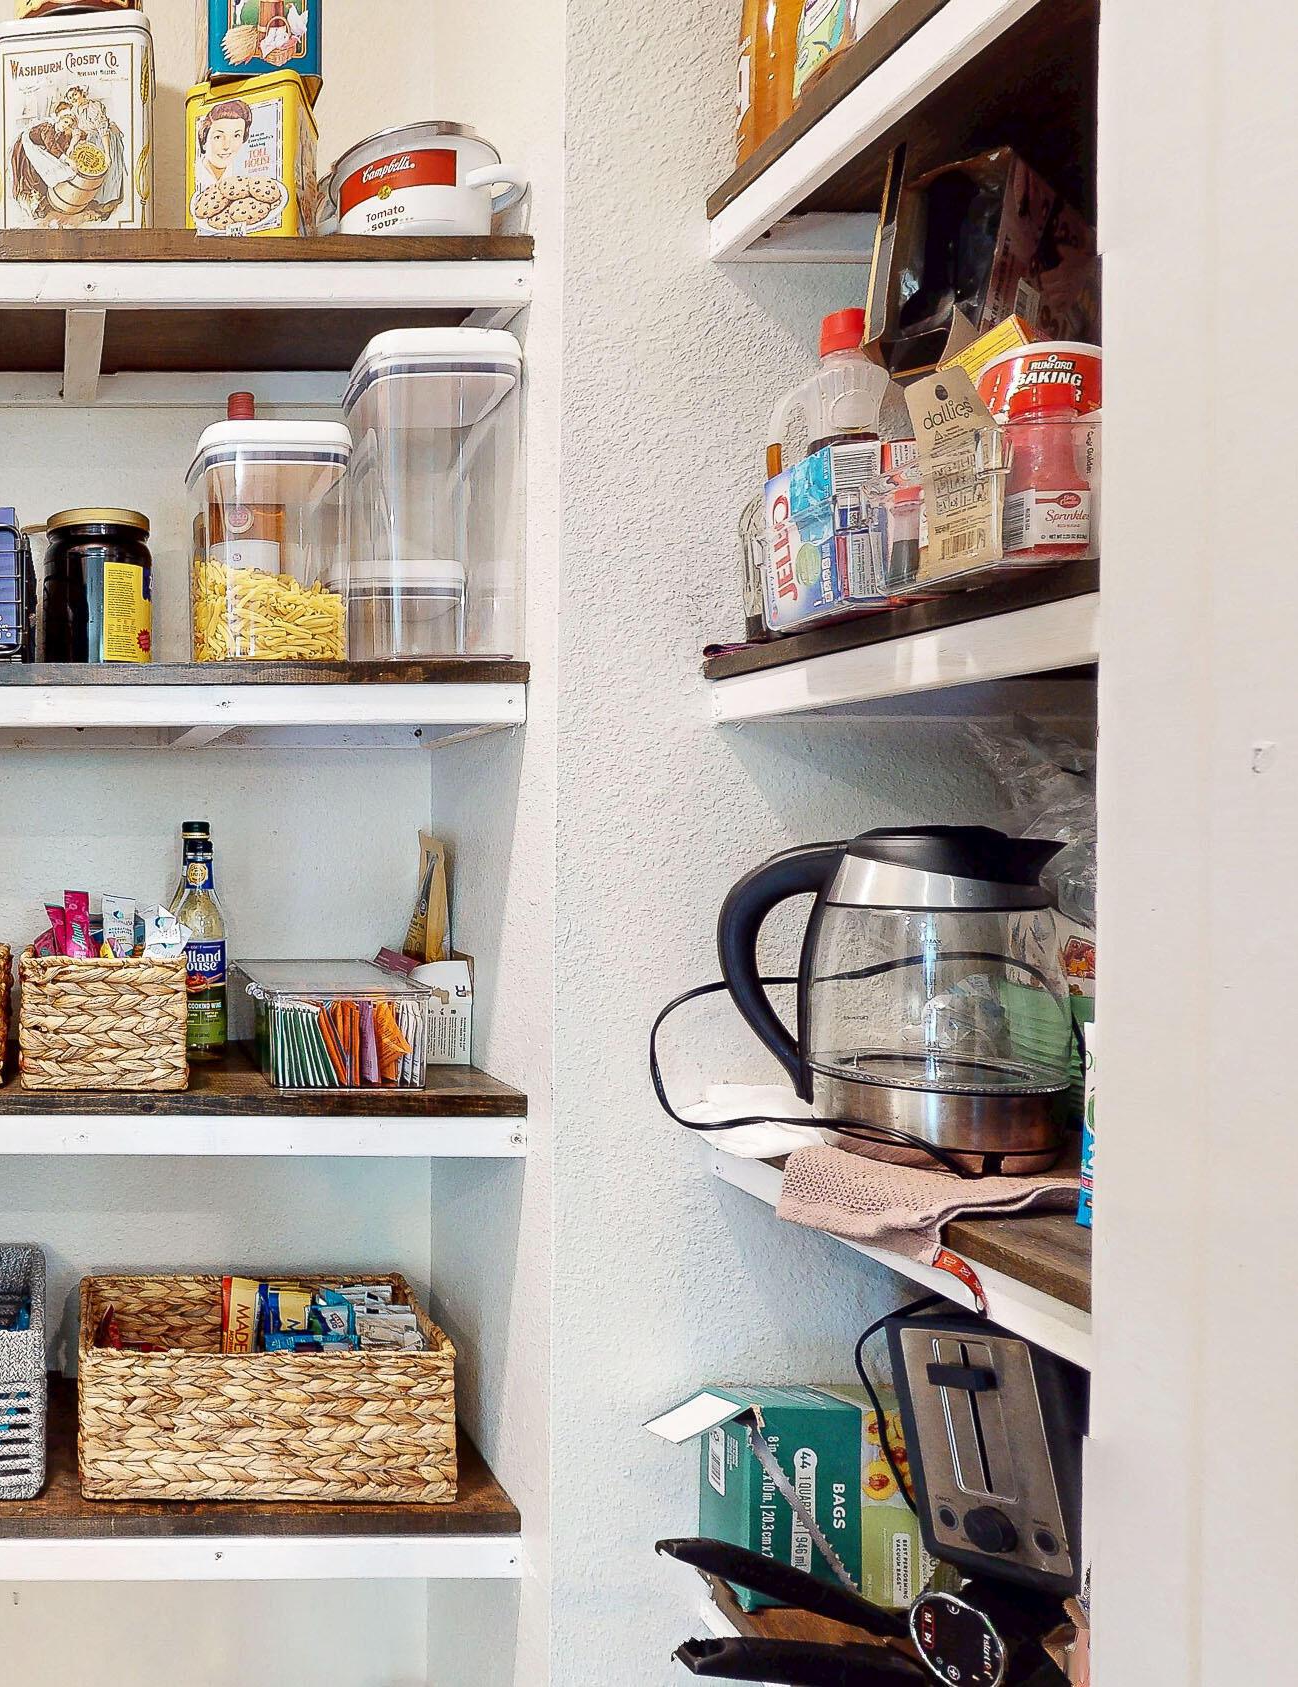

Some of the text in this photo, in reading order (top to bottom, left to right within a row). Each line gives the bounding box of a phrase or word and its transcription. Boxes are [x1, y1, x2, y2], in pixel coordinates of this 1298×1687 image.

[65, 52, 101, 73] CROSBY
[105, 51, 119, 69] CO.
[366, 205, 405, 223] Tomato
[371, 219, 398, 231] SOUP
[1030, 361, 1073, 370] RUMFORD
[1017, 371, 1083, 386] BAKING
[923, 400, 973, 430] dallies
[799, 1451, 811, 1470] 44
[832, 1483, 846, 1529] BAGS
